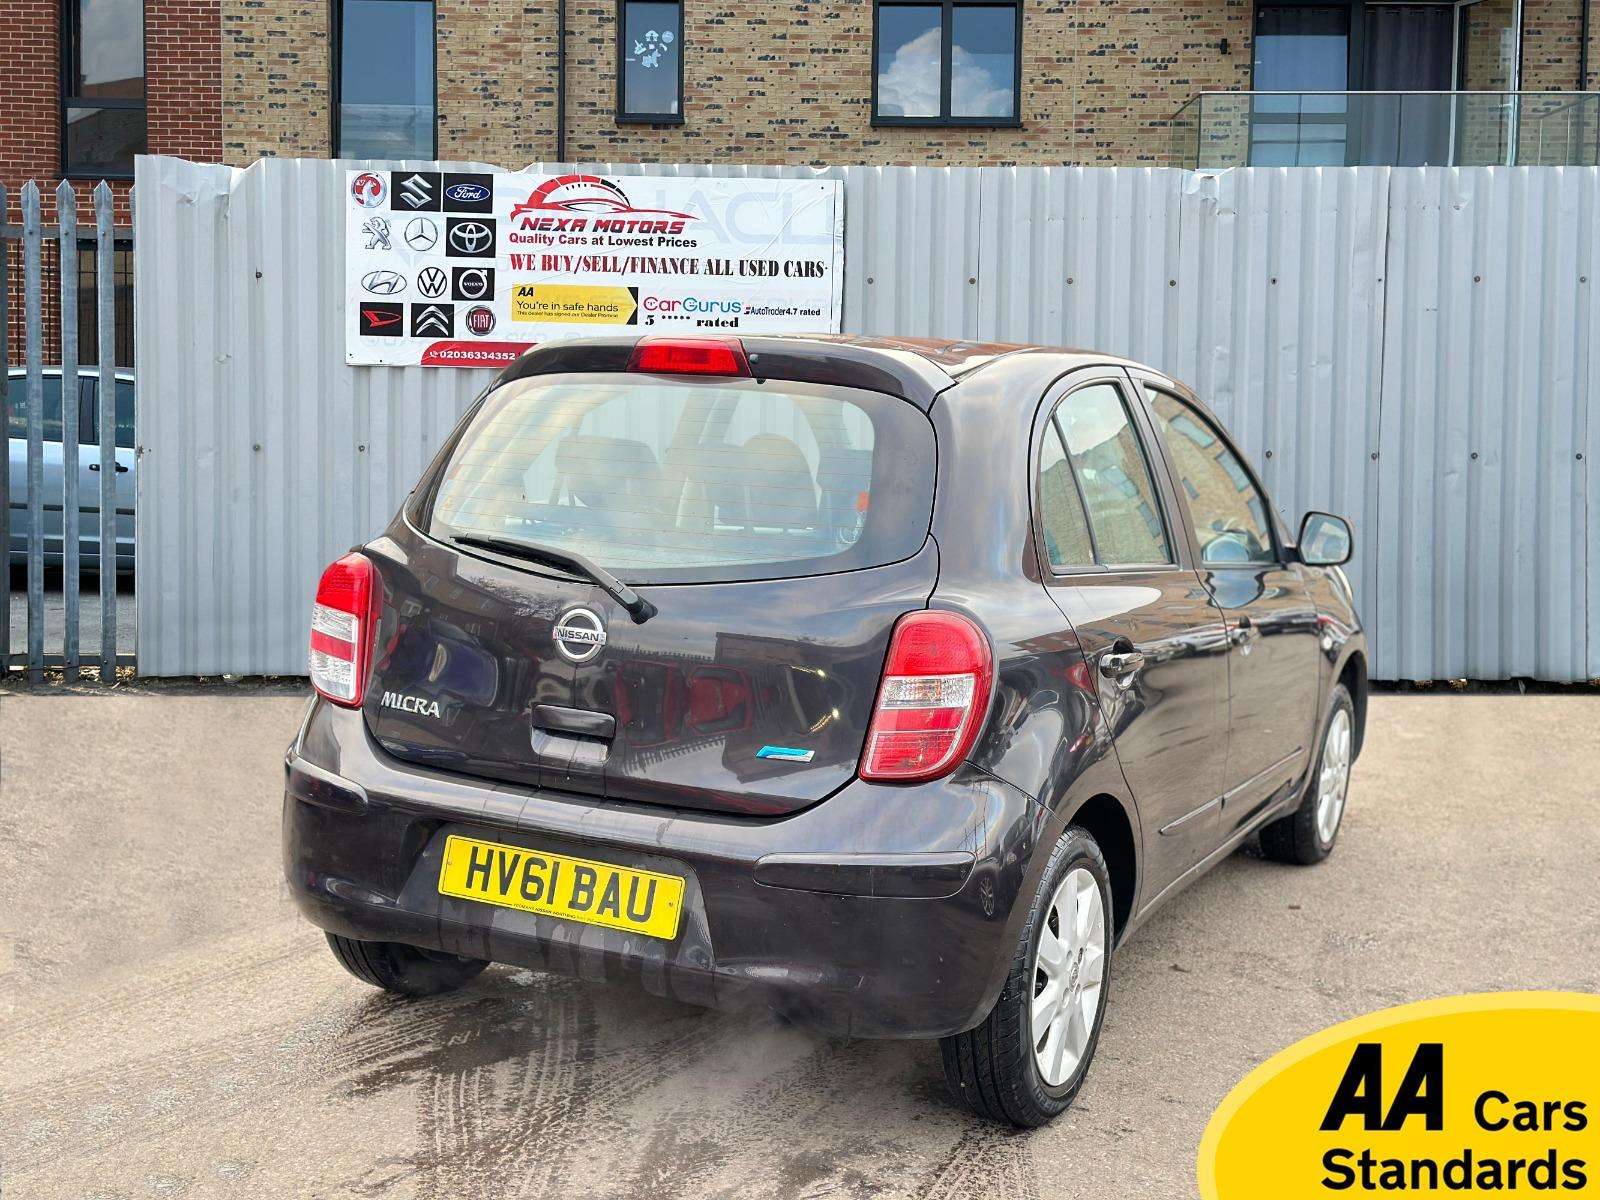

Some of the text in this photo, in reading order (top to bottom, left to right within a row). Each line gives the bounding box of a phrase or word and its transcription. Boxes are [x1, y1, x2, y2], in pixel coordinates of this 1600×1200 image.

[454, 186, 481, 199] Ford
[520, 217, 686, 235] NEXA MOTORS
[509, 232, 698, 248] Quality Cars at Lowest Prices
[509, 253, 825, 278] WE BUY/SELL/FINANCE ALL USED CARS
[517, 286, 534, 297] AA
[516, 300, 619, 312] You're in safe hands
[643, 296, 742, 313] CarGurus
[799, 308, 821, 316] rated
[473, 315, 490, 328] FIAT
[644, 314, 739, 328] 5 rated
[439, 351, 516, 361] 02036334352
[557, 629, 600, 642] NISSAN
[380, 691, 441, 718] MICRA
[465, 846, 658, 924] HV61 BAU
